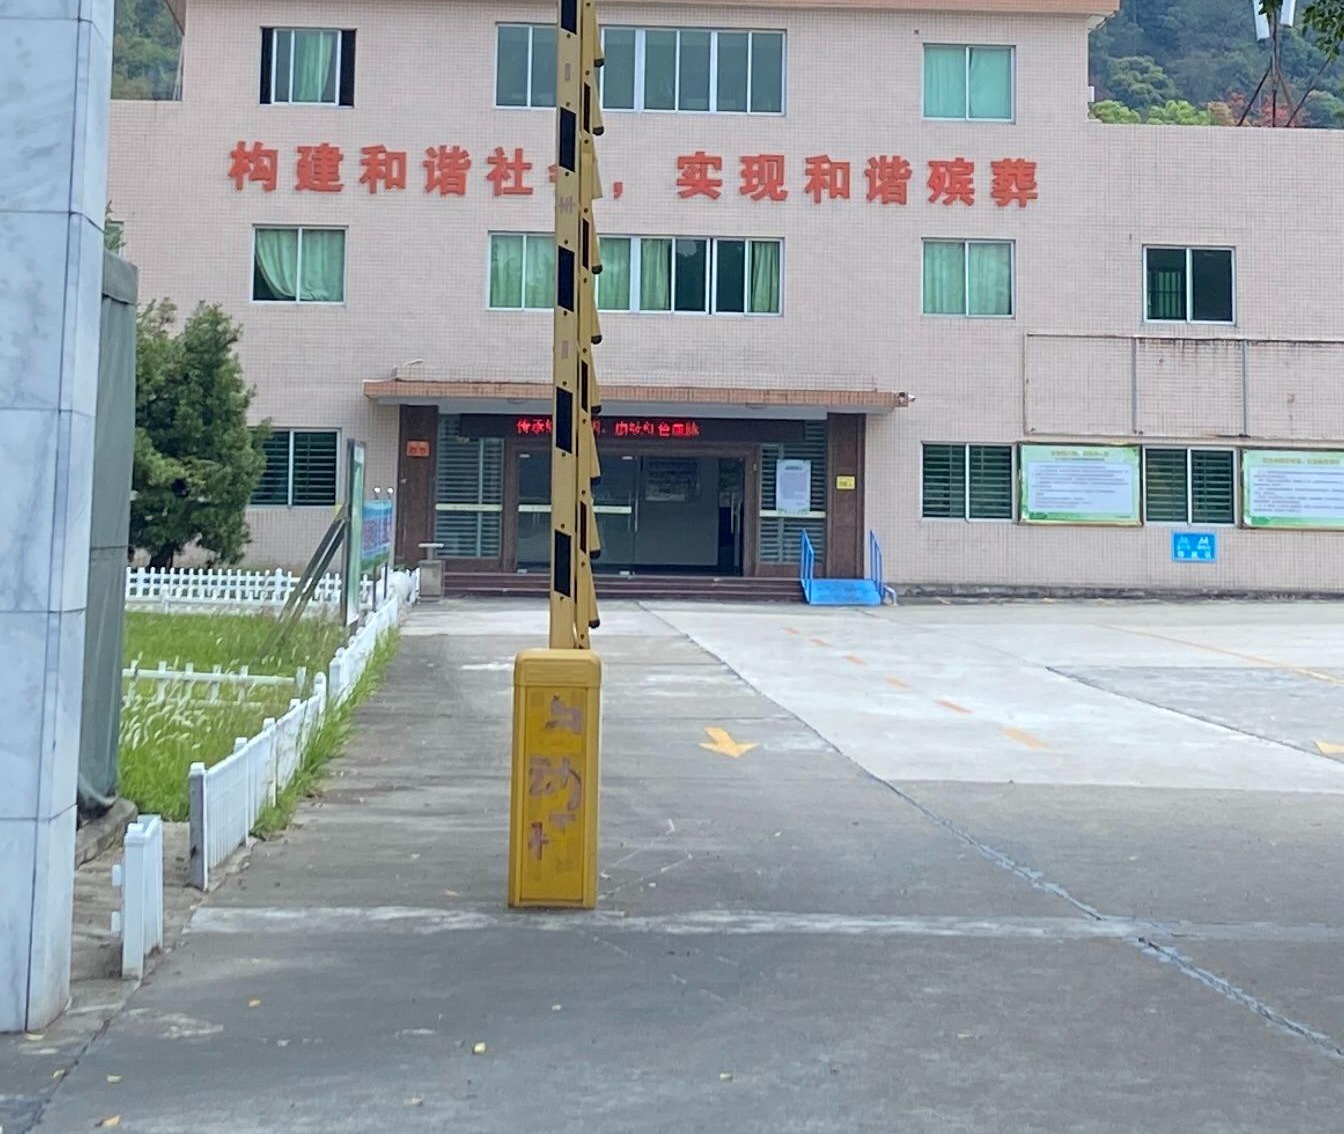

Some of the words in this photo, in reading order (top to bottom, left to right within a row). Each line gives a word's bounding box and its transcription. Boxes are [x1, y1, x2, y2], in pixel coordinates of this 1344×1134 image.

[227, 140, 1039, 208] 构建和谐社，实现和谐殡葬
